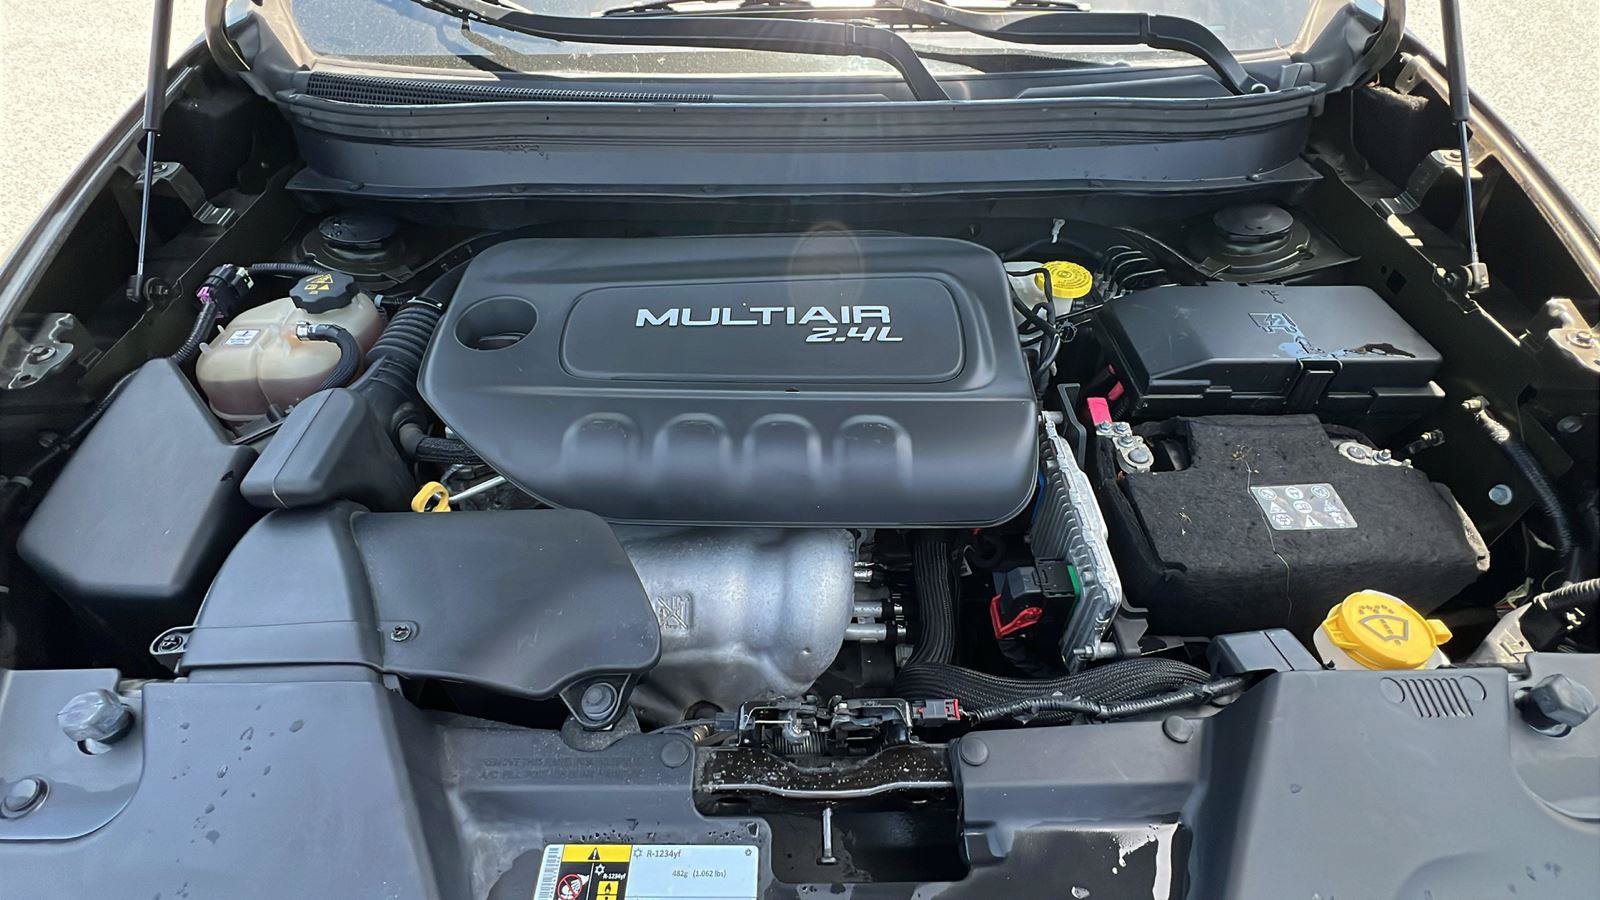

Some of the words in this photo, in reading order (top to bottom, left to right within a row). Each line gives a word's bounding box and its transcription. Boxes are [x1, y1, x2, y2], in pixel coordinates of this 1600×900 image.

[635, 305, 891, 327] MULTIAIR
[805, 326, 903, 343] 2.4L
[646, 849, 682, 859] R-1234yf
